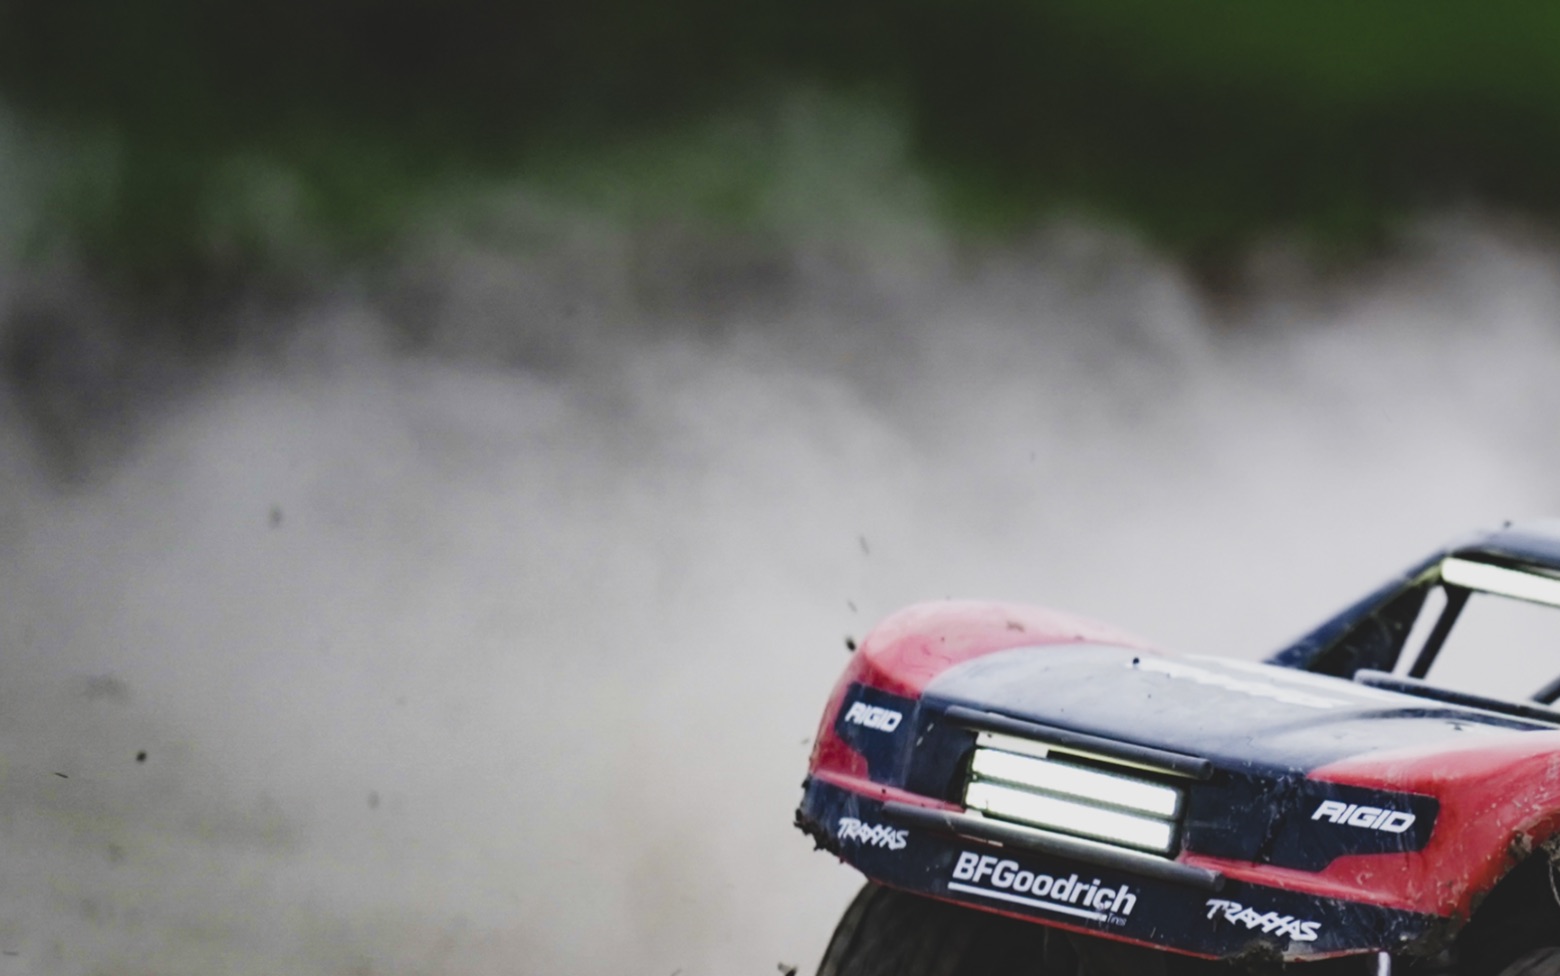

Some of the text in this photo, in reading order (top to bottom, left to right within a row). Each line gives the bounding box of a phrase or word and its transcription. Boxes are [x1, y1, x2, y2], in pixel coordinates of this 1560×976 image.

[845, 701, 902, 732] RIGID
[1311, 800, 1416, 833] RIGID
[838, 817, 909, 850] TRAXXAS
[952, 851, 1136, 915] BFGoodrich
[1206, 899, 1321, 941] TRAXXAS
